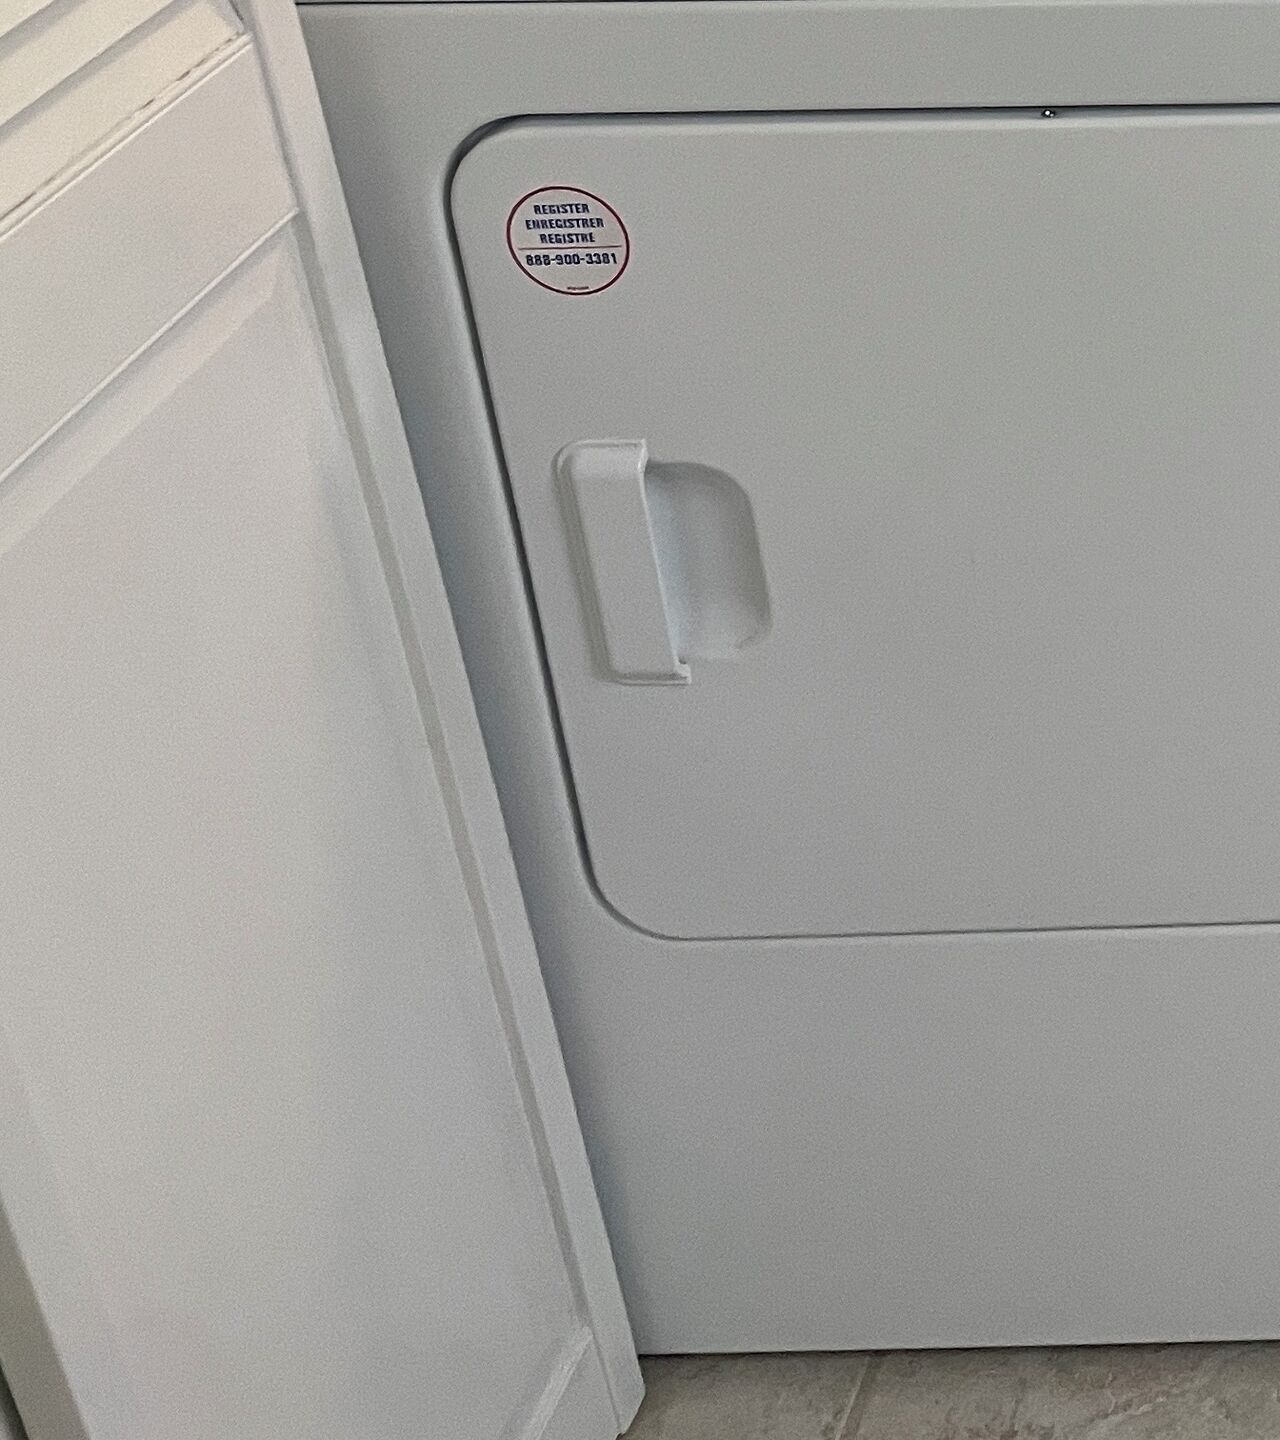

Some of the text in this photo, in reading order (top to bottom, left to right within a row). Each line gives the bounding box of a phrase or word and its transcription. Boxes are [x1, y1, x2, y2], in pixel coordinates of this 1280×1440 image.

[533, 203, 590, 215] REGISTER
[525, 218, 605, 230] ENREGISTRER
[540, 232, 596, 244] REGISTRE
[525, 252, 618, 266] 888-900-3381
